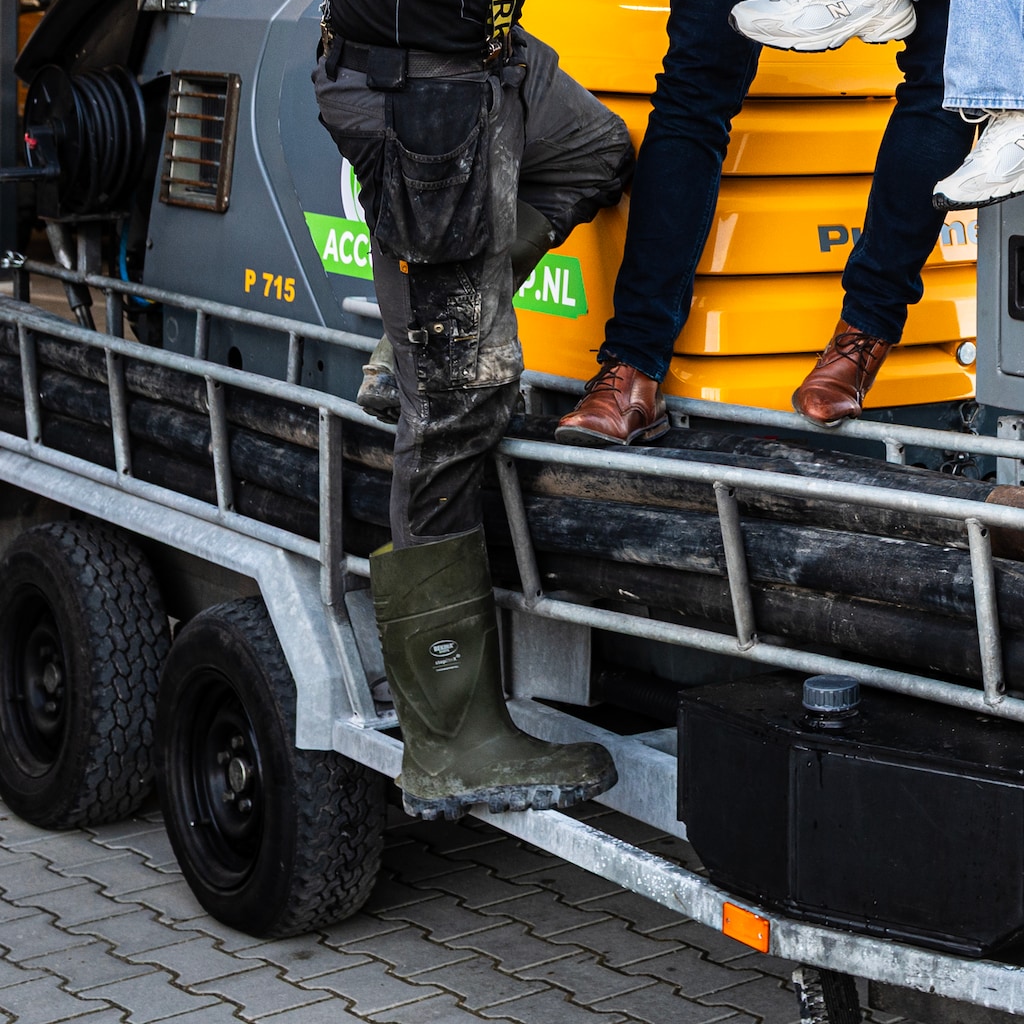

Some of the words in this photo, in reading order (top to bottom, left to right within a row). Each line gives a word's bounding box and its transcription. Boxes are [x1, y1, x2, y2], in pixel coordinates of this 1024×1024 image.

[322, 228, 373, 268] ACC
[244, 268, 257, 293] P
[262, 271, 296, 303] 715
